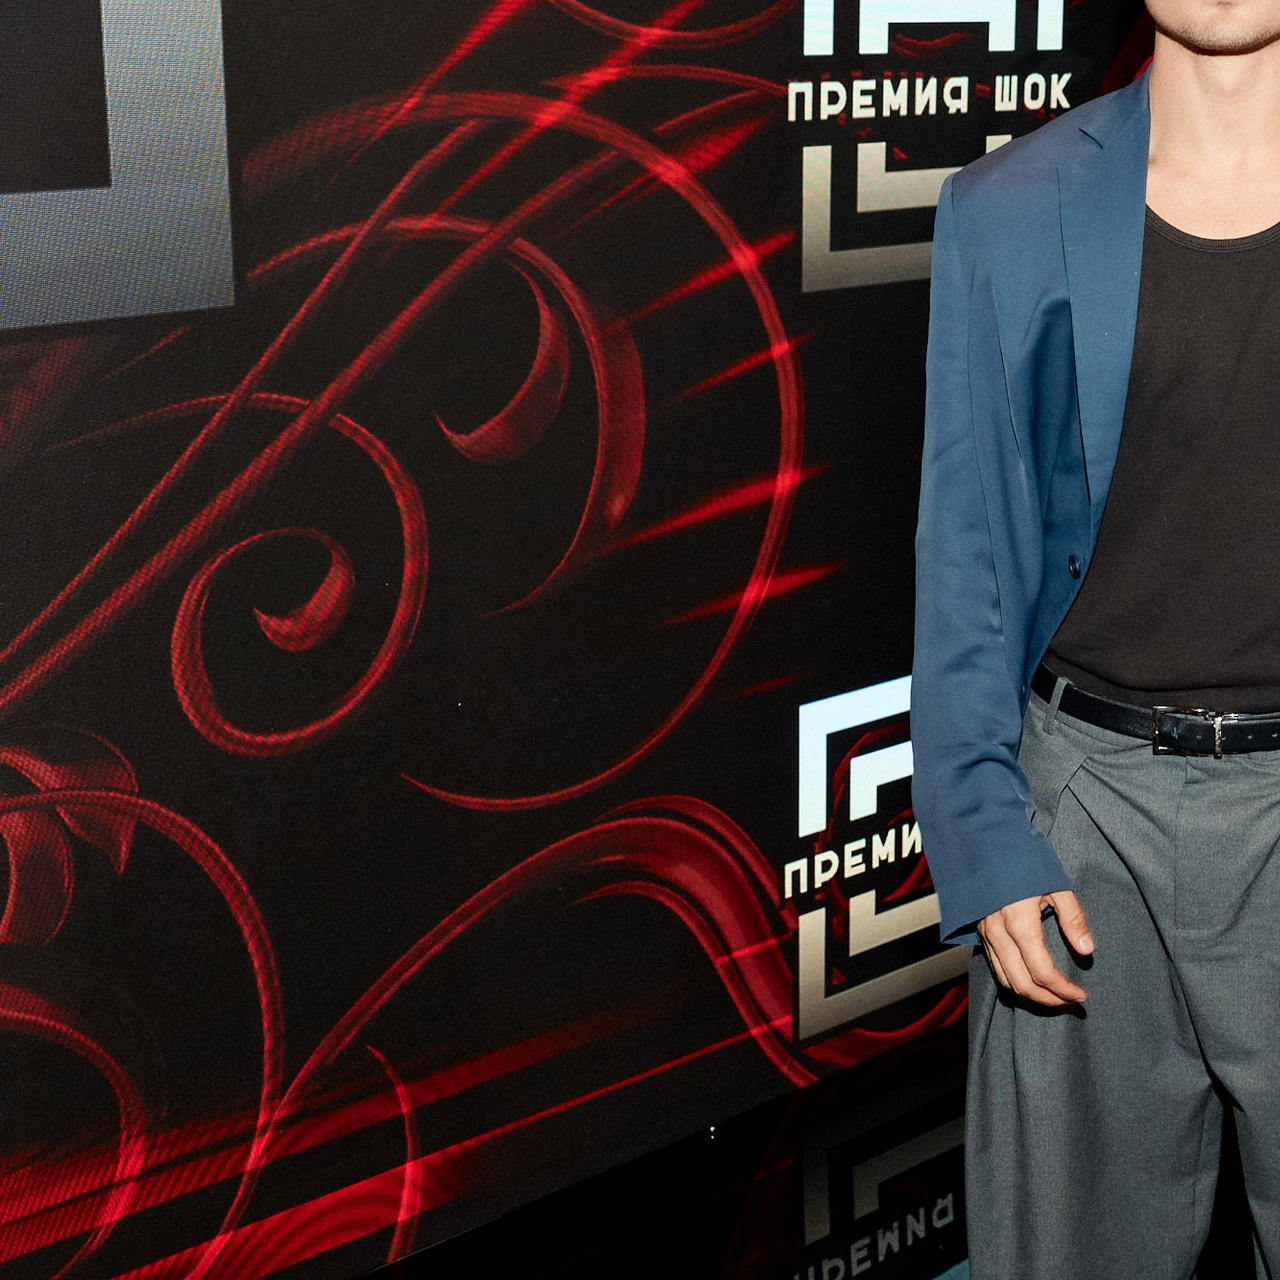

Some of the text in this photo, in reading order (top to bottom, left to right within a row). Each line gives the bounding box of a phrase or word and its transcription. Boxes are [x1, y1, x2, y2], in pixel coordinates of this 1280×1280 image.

[787, 72, 1072, 122] ПРЕМИЯ ШОК
[784, 821, 923, 900] ПРЕМИ
